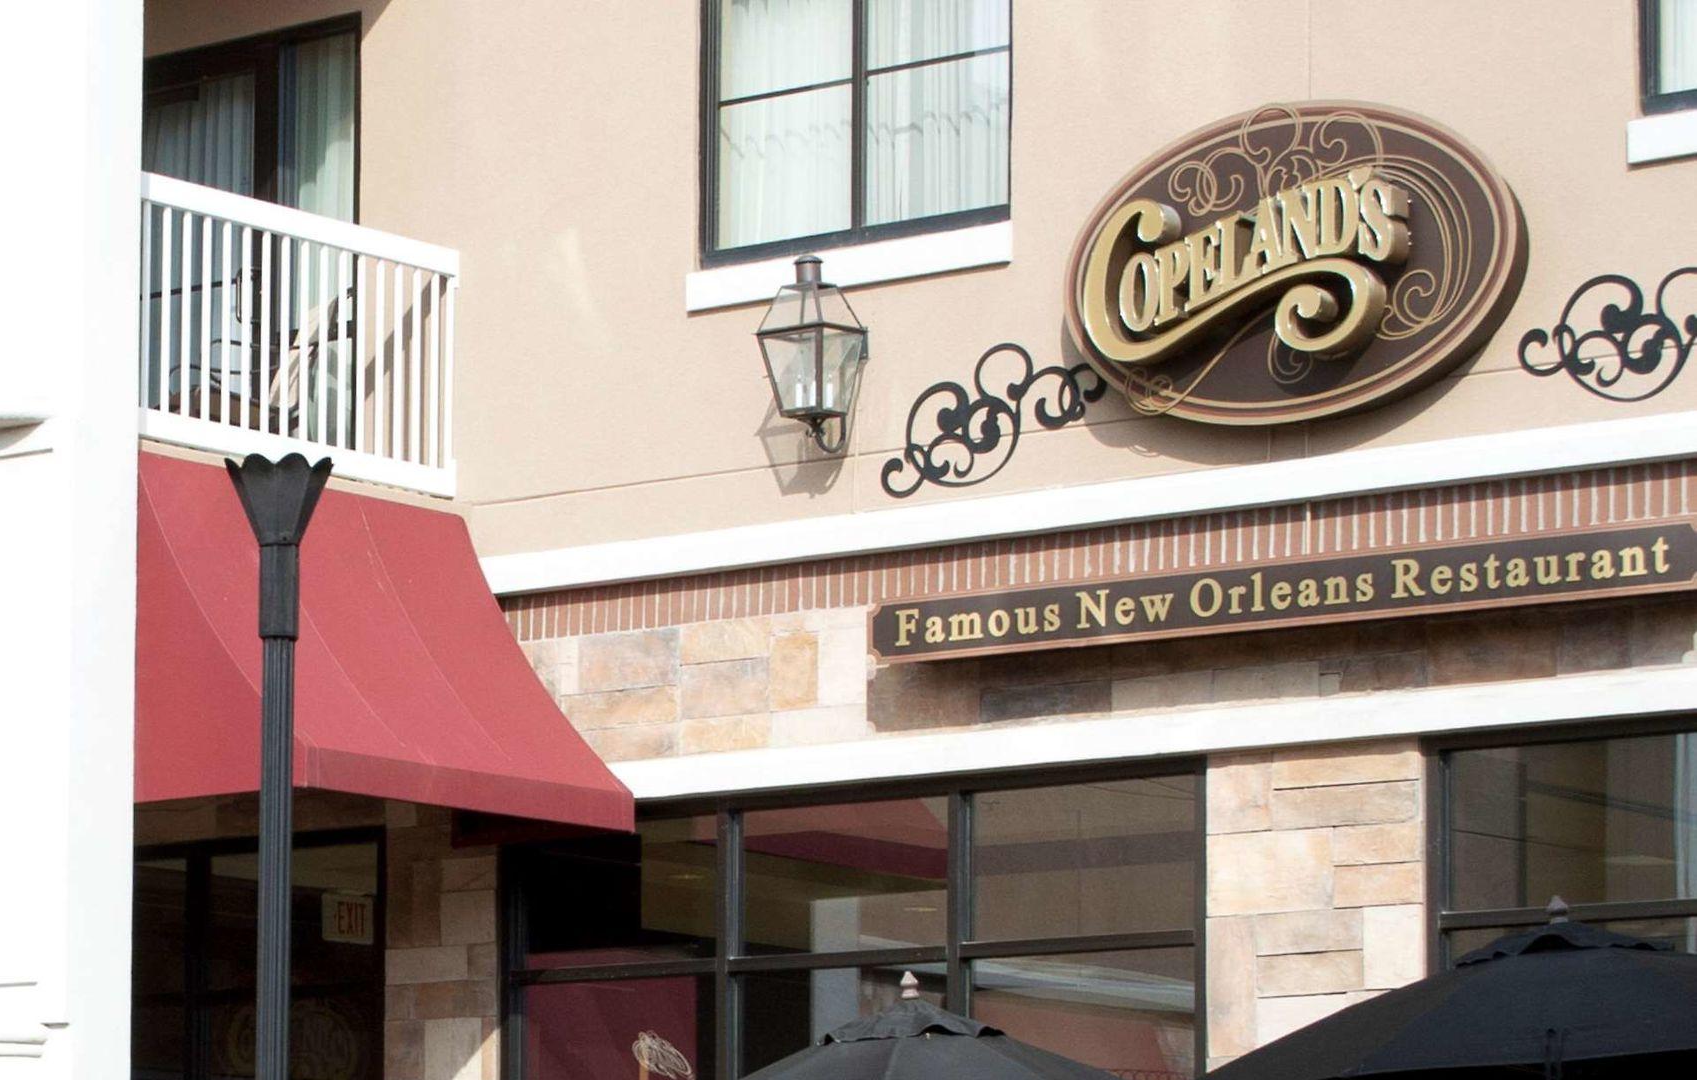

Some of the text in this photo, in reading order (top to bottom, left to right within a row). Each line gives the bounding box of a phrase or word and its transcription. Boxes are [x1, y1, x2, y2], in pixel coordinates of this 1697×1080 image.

[1084, 166, 1398, 362] COPELAND'S
[894, 537, 1670, 646] Famous New Orleans Restaurant
[337, 902, 365, 936] EXIT
